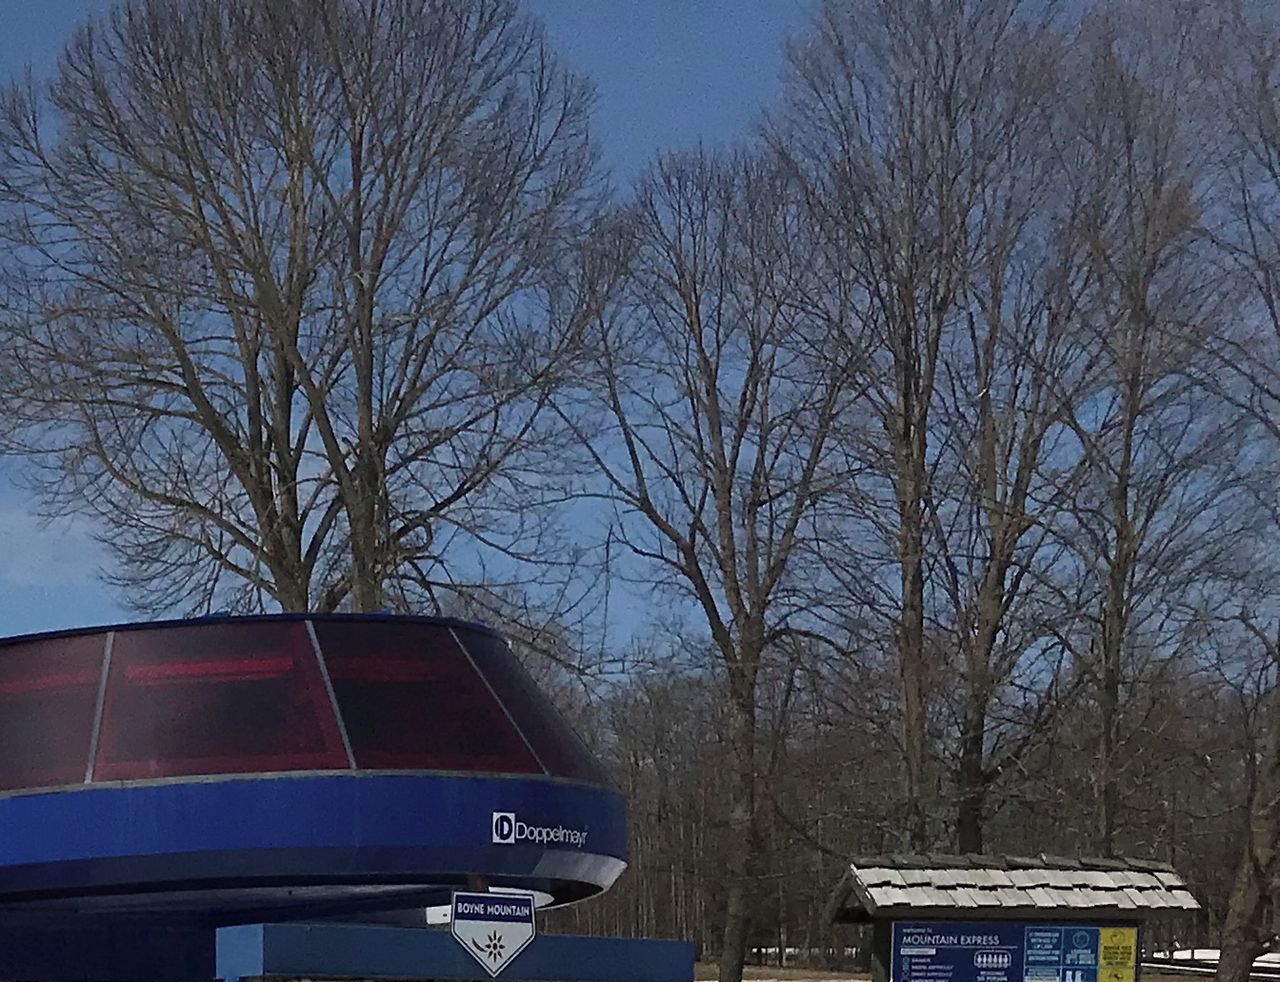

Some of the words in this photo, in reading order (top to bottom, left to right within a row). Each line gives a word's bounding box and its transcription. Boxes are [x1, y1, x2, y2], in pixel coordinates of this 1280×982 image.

[515, 822, 588, 847] Doppelmayr
[457, 902, 485, 915] BOYNE
[487, 904, 530, 917] MOUNTAIN
[902, 935, 958, 945] MOUNTAIN
[960, 935, 1000, 945] EXPRESS
